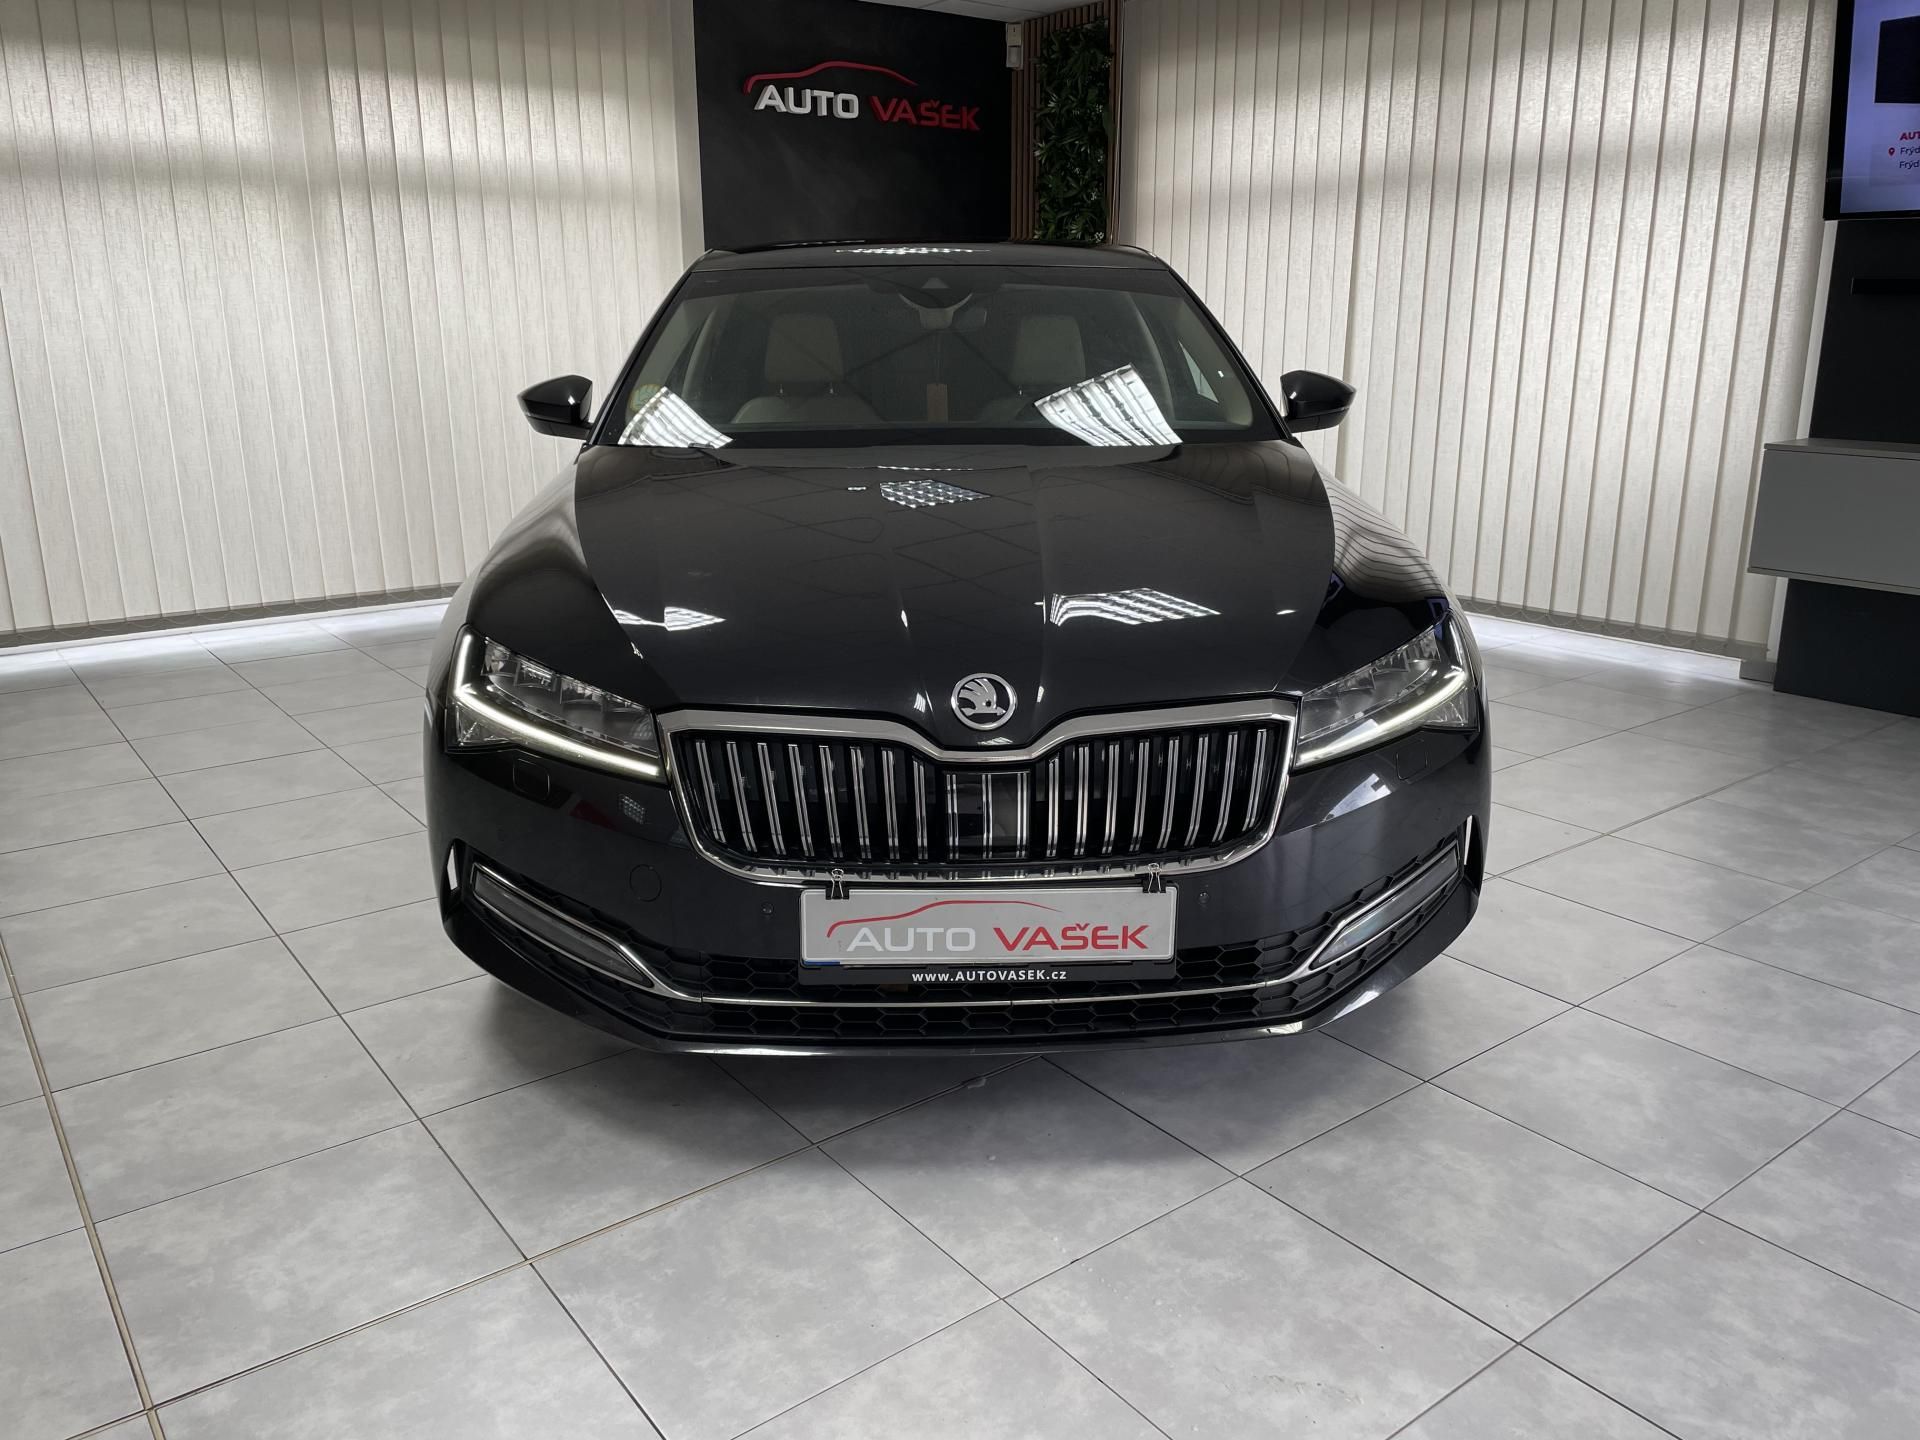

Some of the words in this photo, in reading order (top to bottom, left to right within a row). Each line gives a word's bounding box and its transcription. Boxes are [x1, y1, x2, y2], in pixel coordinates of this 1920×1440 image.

[754, 84, 859, 119] AUTO
[871, 95, 981, 131] VAŠEK
[846, 926, 976, 953] AUTO
[992, 922, 1151, 951] VAŠEK
[911, 969, 1067, 983] www.AUTOVASEK.cz
